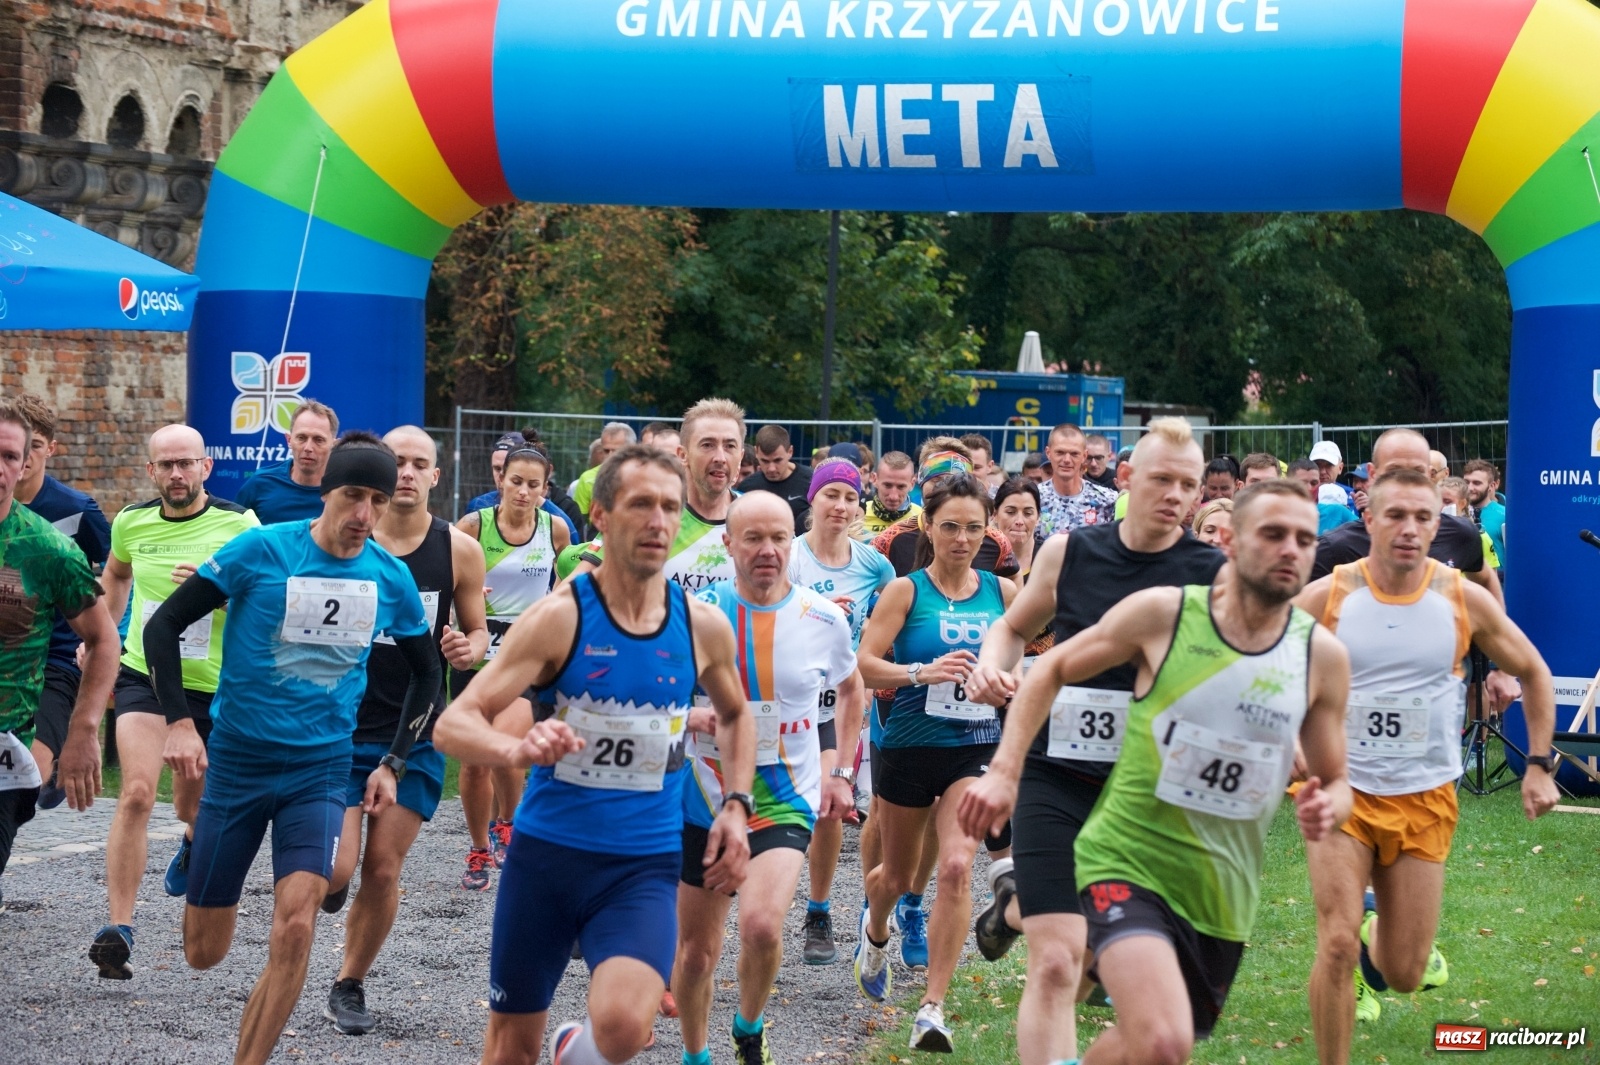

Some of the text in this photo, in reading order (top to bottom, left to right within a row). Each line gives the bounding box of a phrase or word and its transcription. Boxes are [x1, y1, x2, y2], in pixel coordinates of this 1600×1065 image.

[616, 0, 806, 38] GMINA
[823, 83, 1059, 168] META
[140, 287, 183, 316] pepsi
[1540, 469, 1593, 485] GMINA
[157, 545, 206, 554] RUNNING
[322, 599, 340, 626] 2
[1079, 710, 1115, 740] 33
[1367, 711, 1401, 738] 35
[0, 749, 14, 770] 4
[592, 737, 635, 768] 26
[1200, 758, 1244, 793] 48
